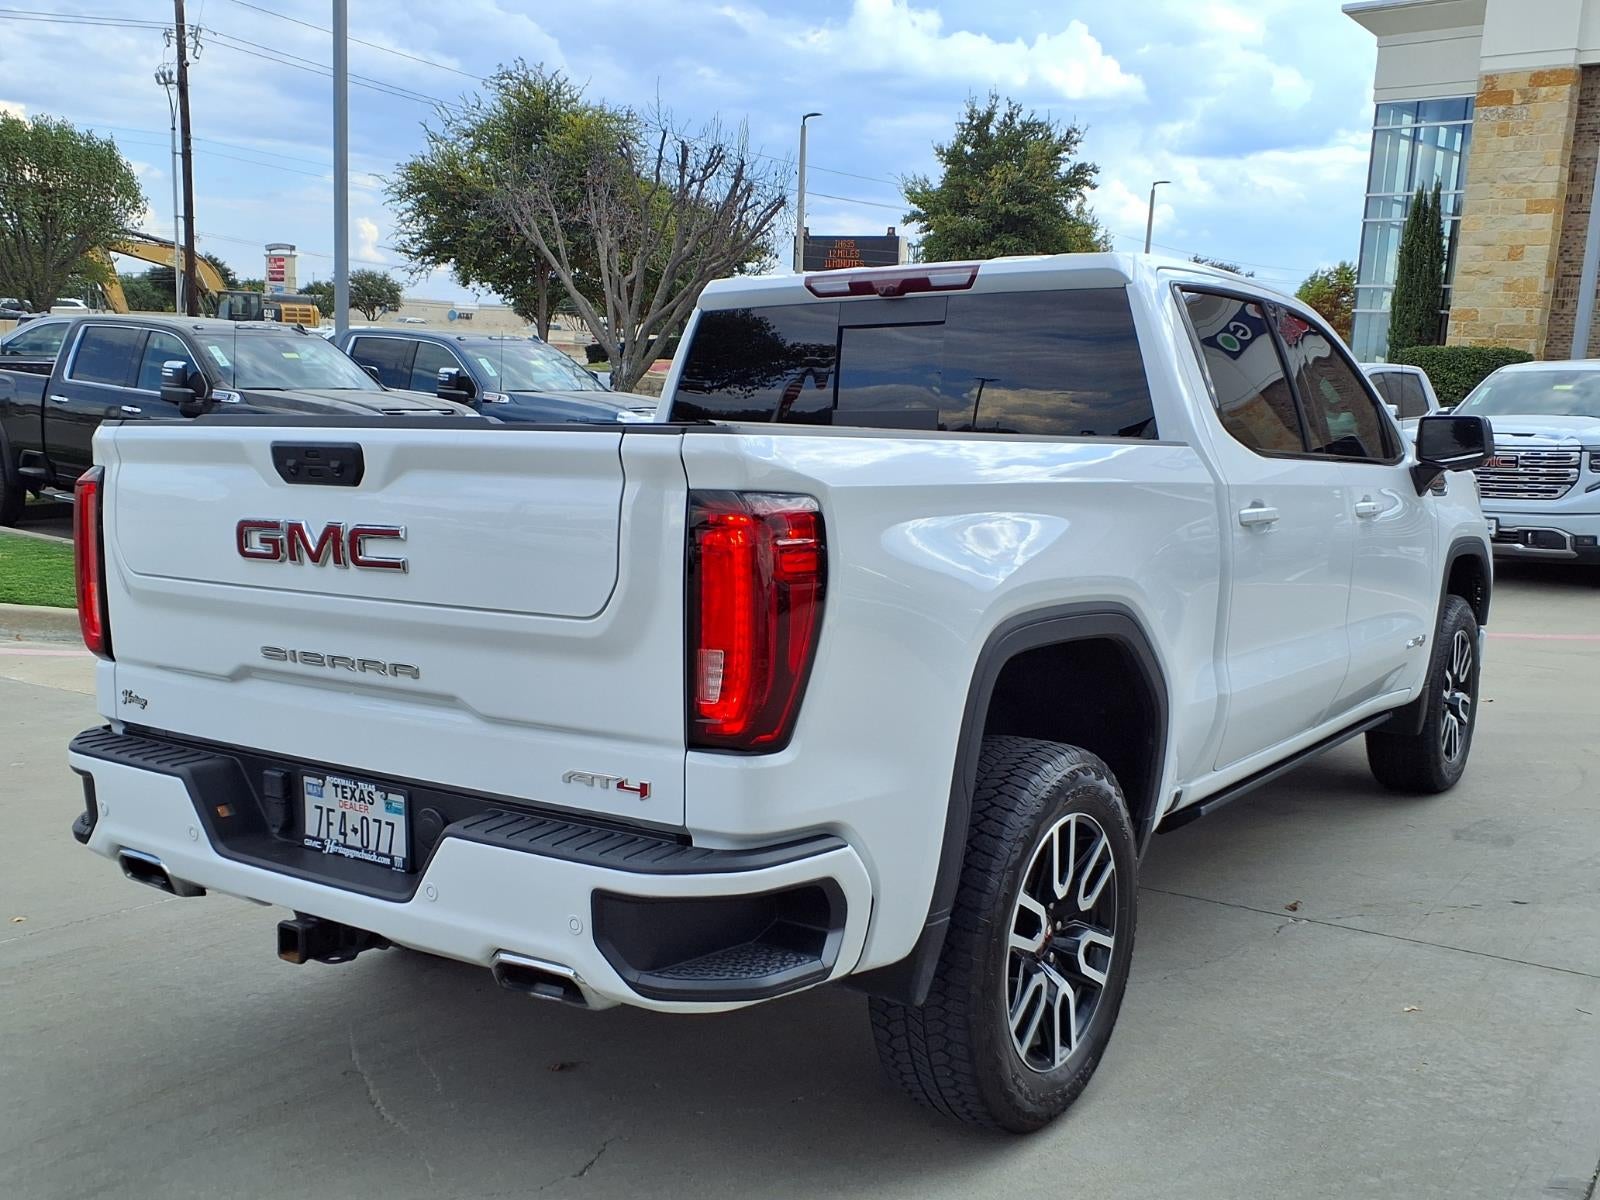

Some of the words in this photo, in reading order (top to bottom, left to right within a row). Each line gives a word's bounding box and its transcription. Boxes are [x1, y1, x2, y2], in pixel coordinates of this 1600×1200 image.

[837, 249, 860, 258] MILES
[831, 259, 865, 268] MINUTES
[457, 312, 474, 320] AT&T
[236, 518, 409, 575] GMC
[260, 645, 420, 680] SIERRA
[562, 769, 651, 800] AT4
[332, 783, 375, 805] TEXAS
[338, 800, 369, 813] DEALER
